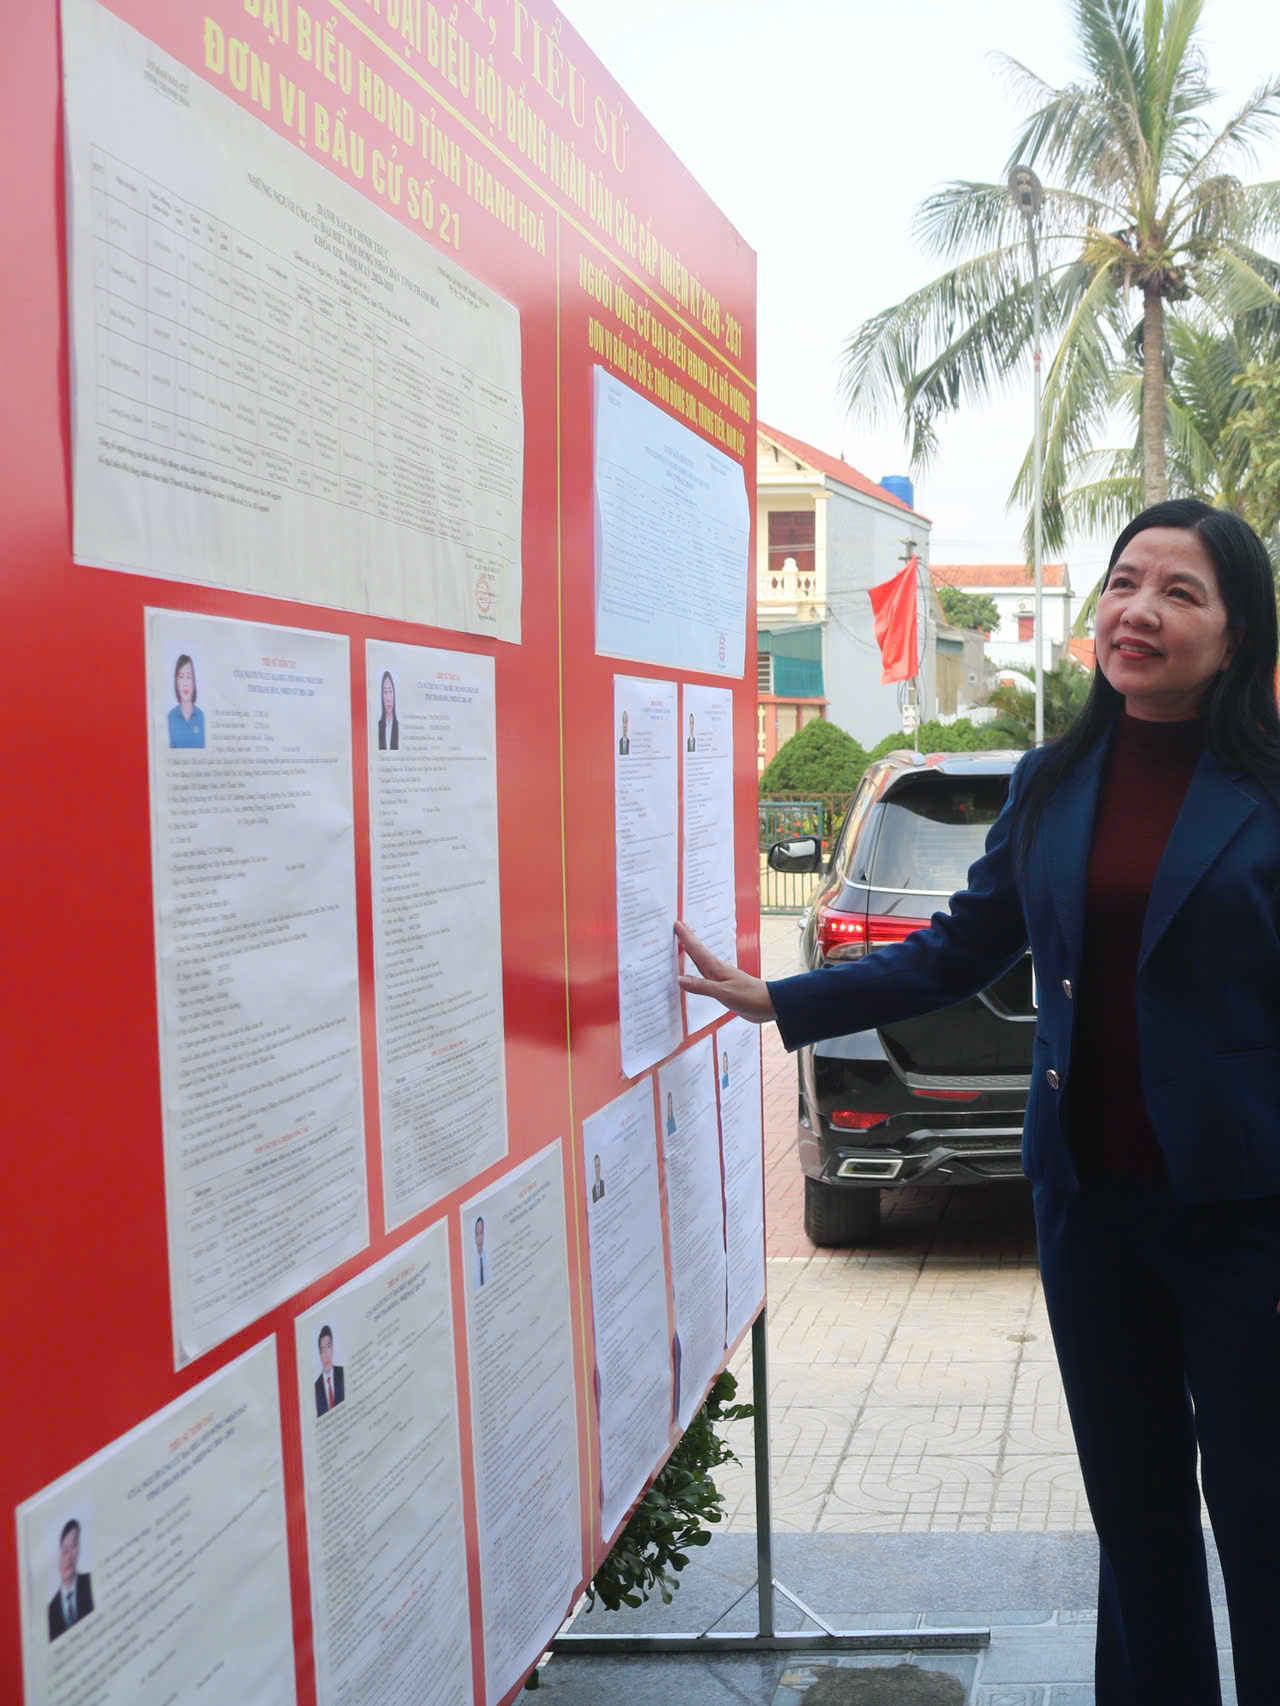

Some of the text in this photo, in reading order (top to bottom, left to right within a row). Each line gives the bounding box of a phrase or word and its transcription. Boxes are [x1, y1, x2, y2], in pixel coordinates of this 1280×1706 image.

[204, 15, 271, 112] ĐƠN
[279, 73, 306, 148] VỊ
[313, 102, 365, 180] BẦU
[371, 143, 404, 207] CỬ
[407, 175, 436, 231] SỐ
[438, 201, 460, 250] 21
[242, 0, 289, 47] ẠI
[297, 5, 353, 95] BIỂU
[359, 60, 415, 147] HĐND
[419, 107, 462, 187] TỈNH
[464, 152, 516, 232] THANH
[427, 2, 470, 98] BIỂU
[474, 51, 503, 137] HỘI
[506, 81, 547, 175] ĐỒNG
[550, 129, 587, 213] NHÂN
[589, 168, 614, 240] DÂN
[615, 197, 637, 260] CÁC
[638, 216, 658, 278] CẤP
[660, 242, 690, 312] NHIỆM
[690, 271, 701, 321] KỲ
[702, 286, 721, 340] 2026
[725, 311, 742, 361] 2031
[505, 0, 629, 174] TIỂU SỬ
[579, 252, 613, 313] NGƯỜI
[614, 276, 636, 331] ỨNG
[637, 297, 651, 343] CỬ
[651, 316, 667, 360] ĐẠI
[668, 328, 687, 372] BIỂU
[687, 348, 708, 390] HĐND
[588, 315, 605, 356] ĐƠN
[605, 327, 613, 369] VỊ
